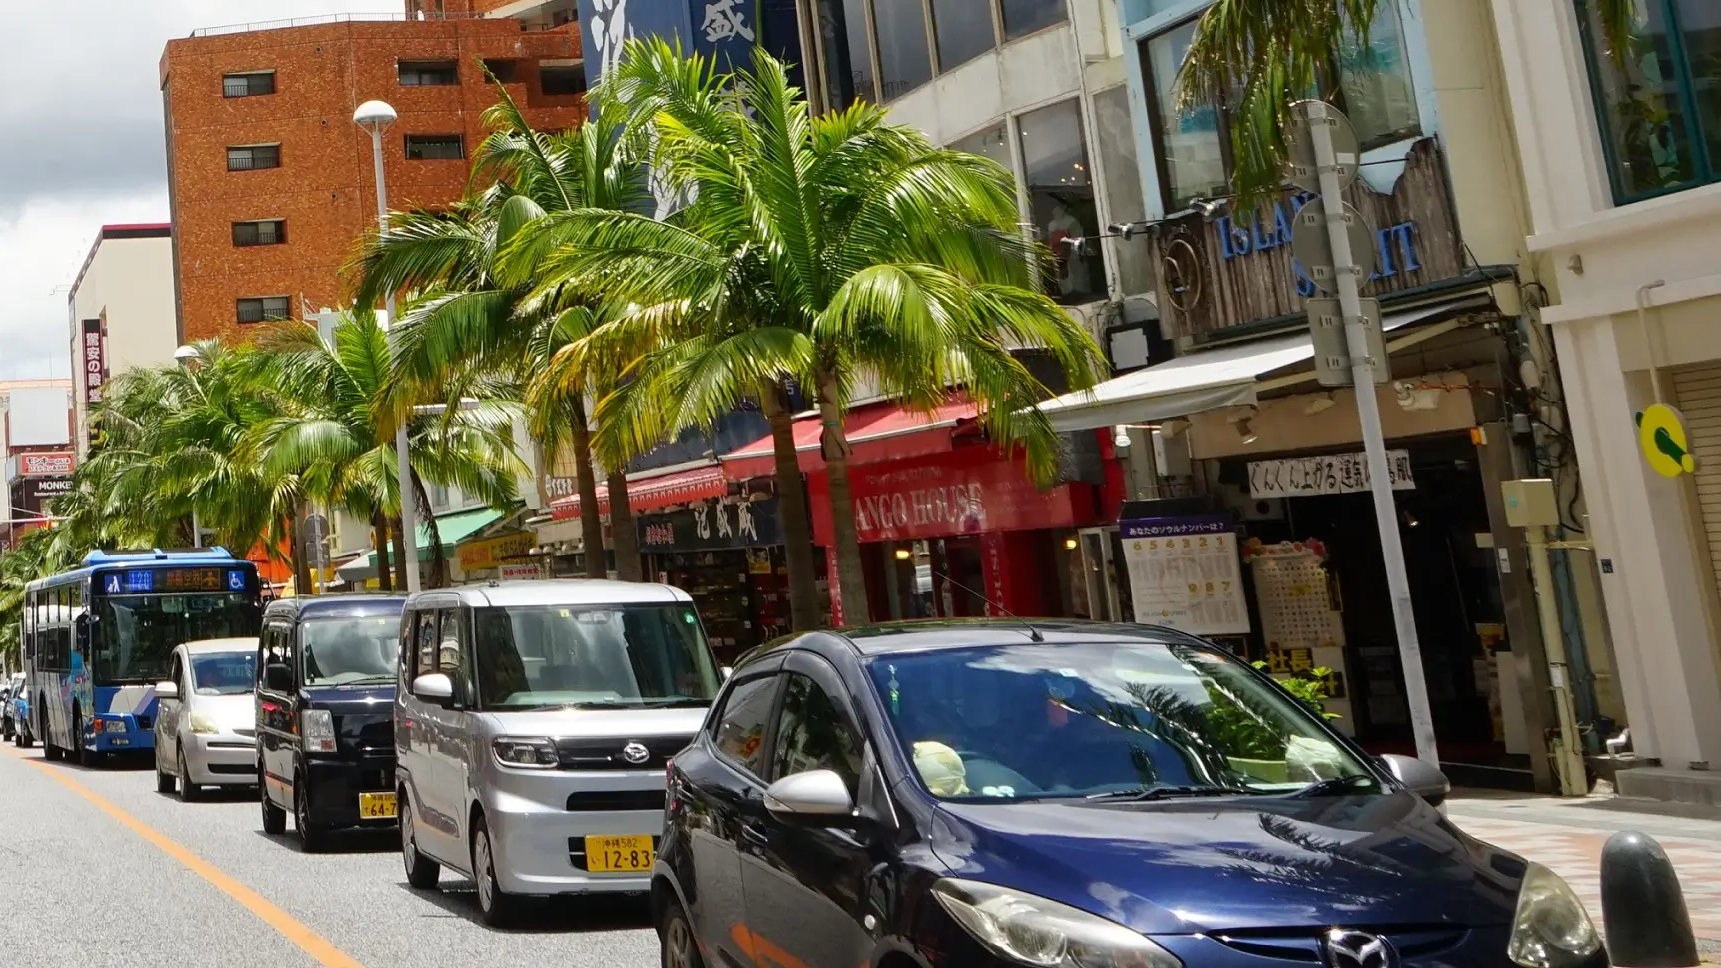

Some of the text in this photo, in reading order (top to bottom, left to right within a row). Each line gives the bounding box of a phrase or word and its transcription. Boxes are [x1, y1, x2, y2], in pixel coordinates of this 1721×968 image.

[855, 481, 988, 532] ANGO HOUSE
[604, 849, 651, 868] 12-83
